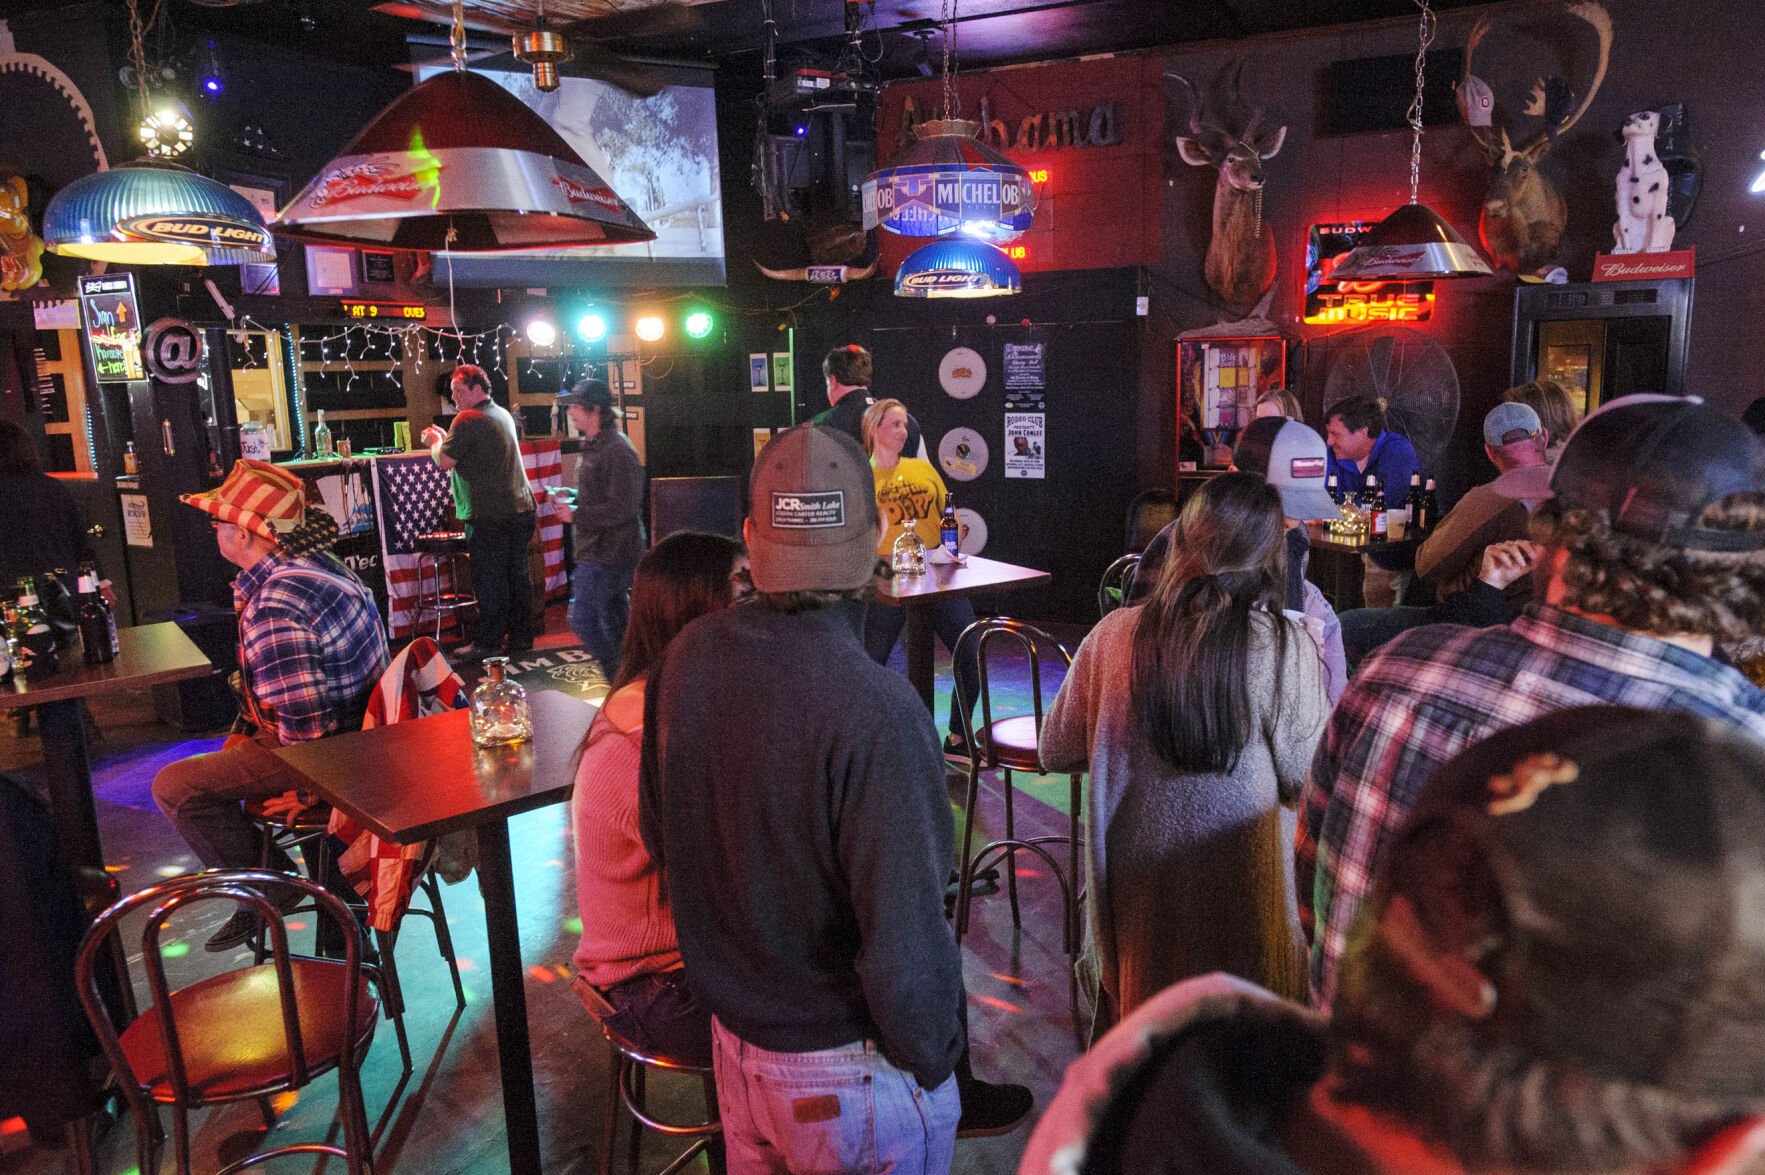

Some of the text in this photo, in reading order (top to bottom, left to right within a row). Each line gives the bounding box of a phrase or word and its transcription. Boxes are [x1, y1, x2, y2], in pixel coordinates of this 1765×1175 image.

[938, 183, 1019, 205] MICHELOB
[151, 222, 264, 243] BUD LIGHT
[1601, 262, 1687, 277] Budweiser
[910, 274, 982, 284] BUD LIGHT
[1317, 293, 1420, 307] TRUE
[352, 305, 366, 316] AT
[369, 305, 378, 317] 9
[1008, 429, 1022, 437] JOHN
[775, 497, 800, 510] JCR
[822, 501, 840, 510] Lake
